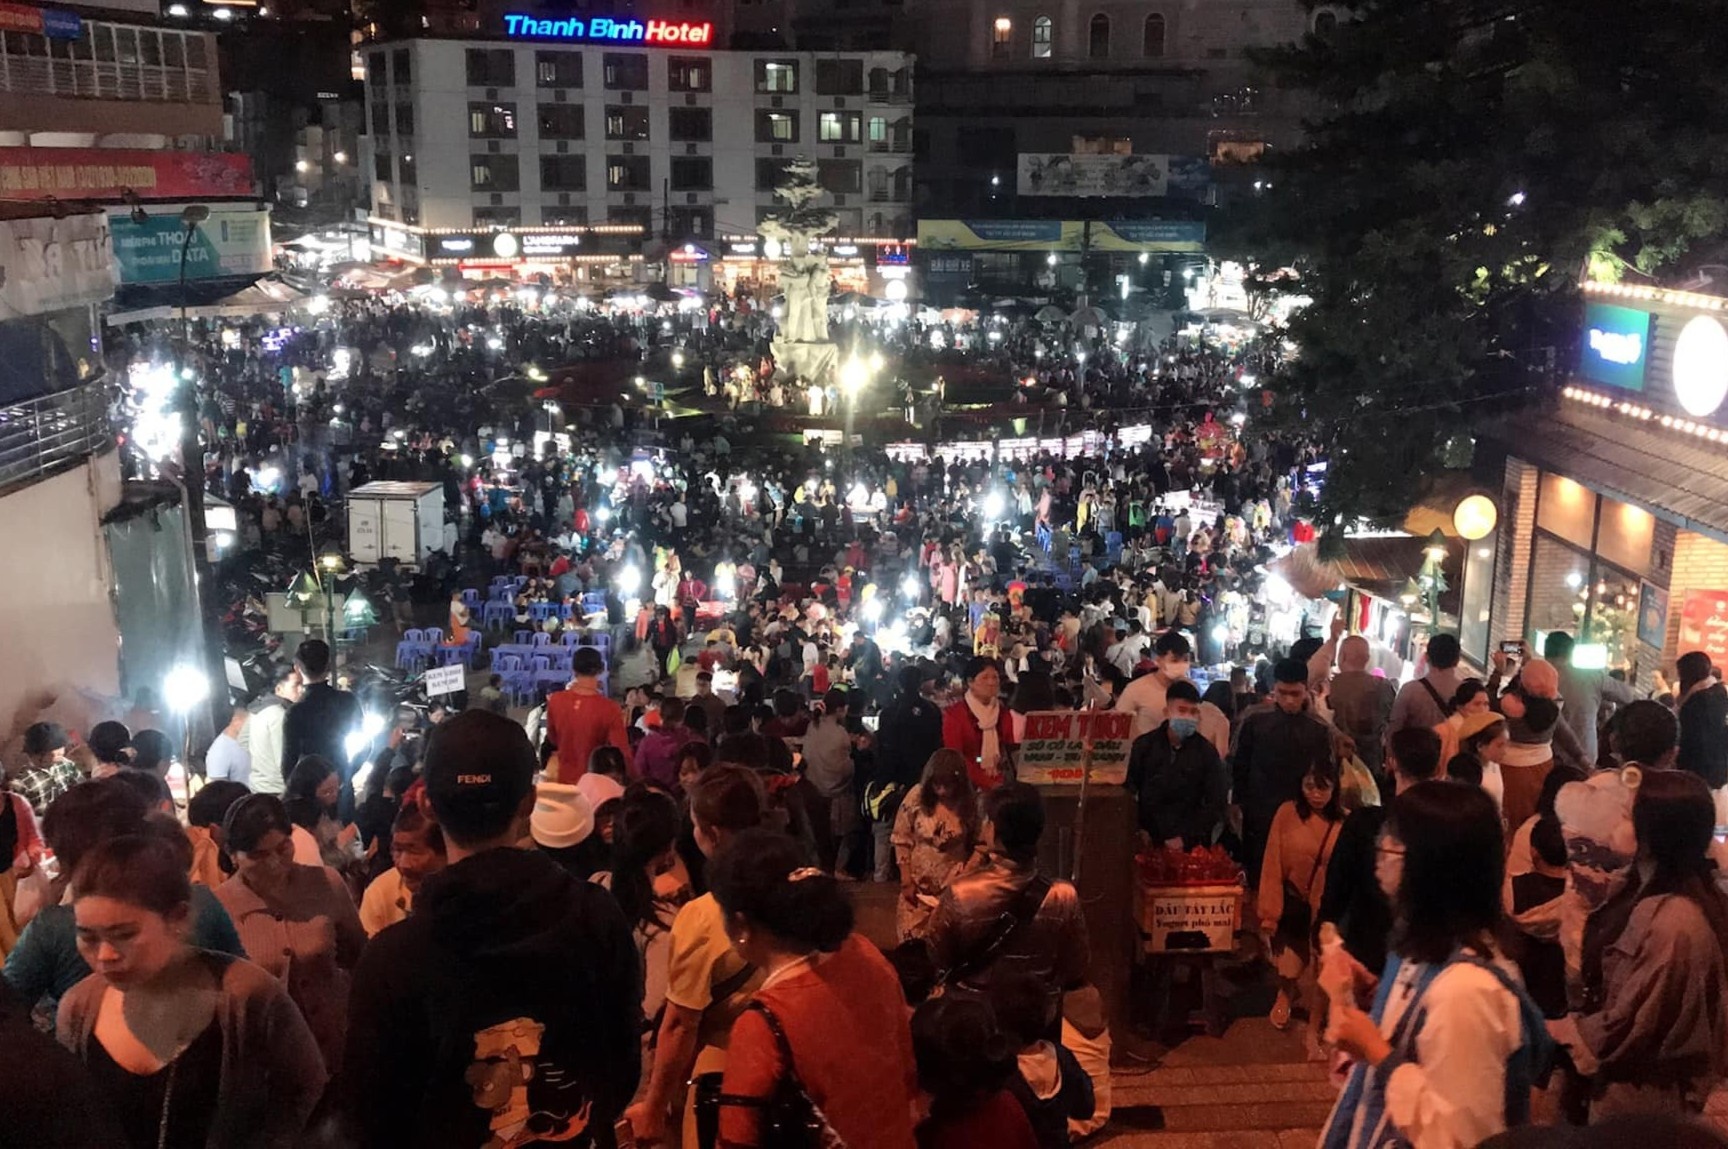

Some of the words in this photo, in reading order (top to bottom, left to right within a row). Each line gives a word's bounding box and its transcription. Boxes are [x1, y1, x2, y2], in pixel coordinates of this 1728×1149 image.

[504, 15, 584, 37] Thanh
[589, 18, 644, 39] Bình
[645, 20, 711, 42] Hotel
[172, 247, 209, 263] DATA
[1023, 714, 1072, 740] KEM
[457, 774, 492, 784] FENDI
